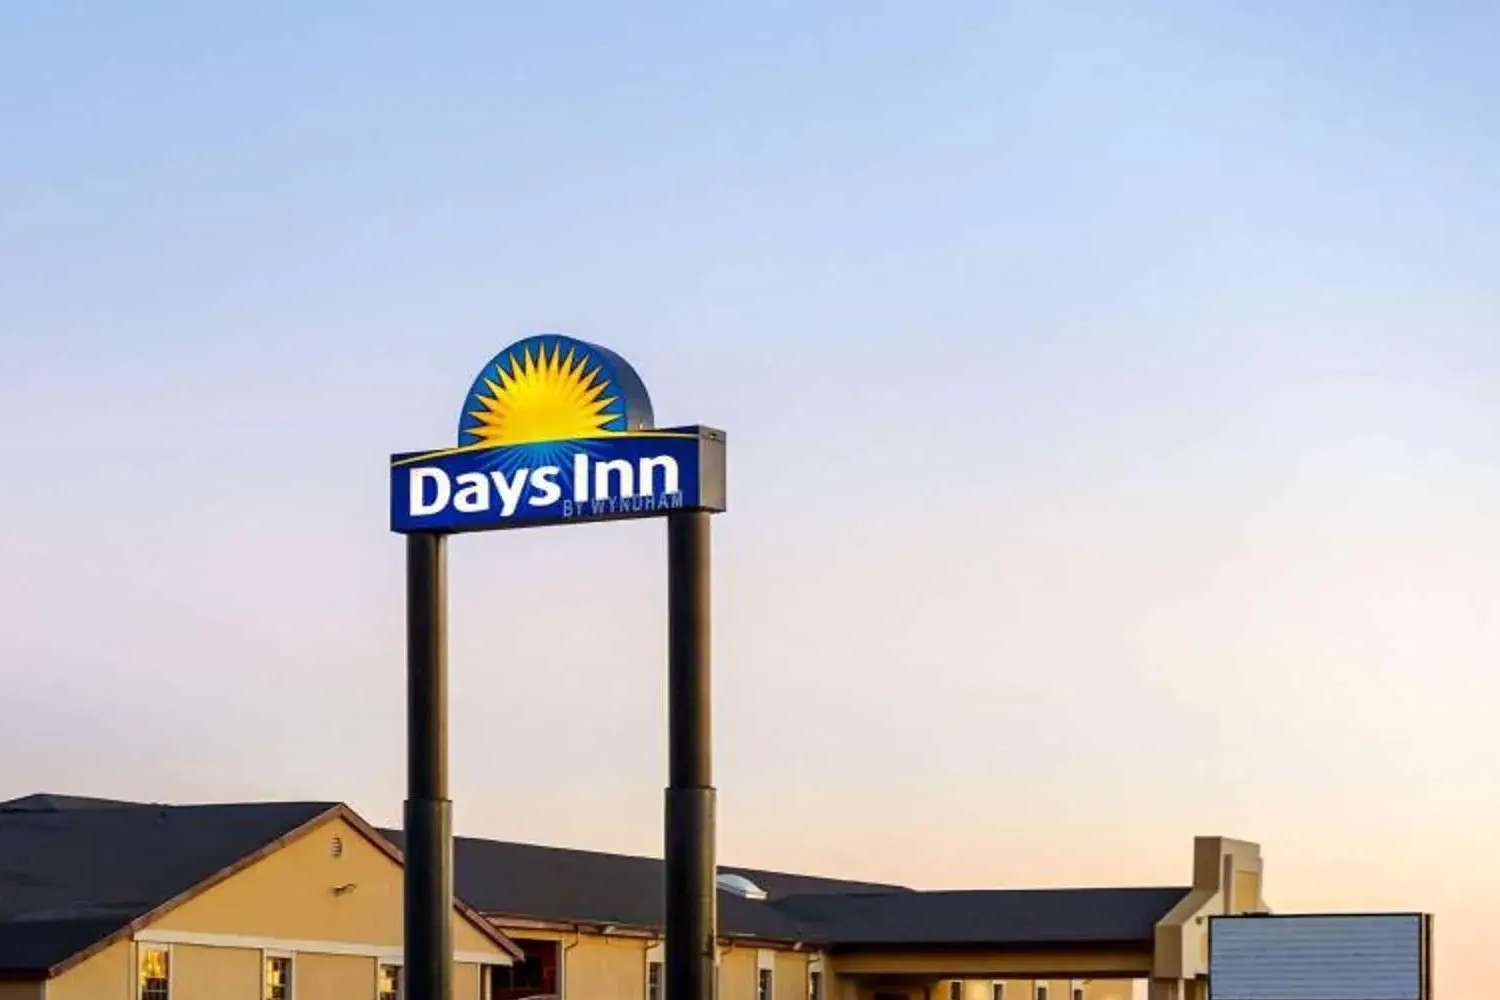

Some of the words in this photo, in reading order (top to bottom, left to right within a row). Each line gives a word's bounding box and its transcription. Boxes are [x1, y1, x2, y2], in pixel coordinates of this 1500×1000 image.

[409, 466, 561, 517] Days
[574, 453, 679, 502] Inn
[563, 500, 585, 517] BY
[591, 490, 683, 514] WYNDHAM
